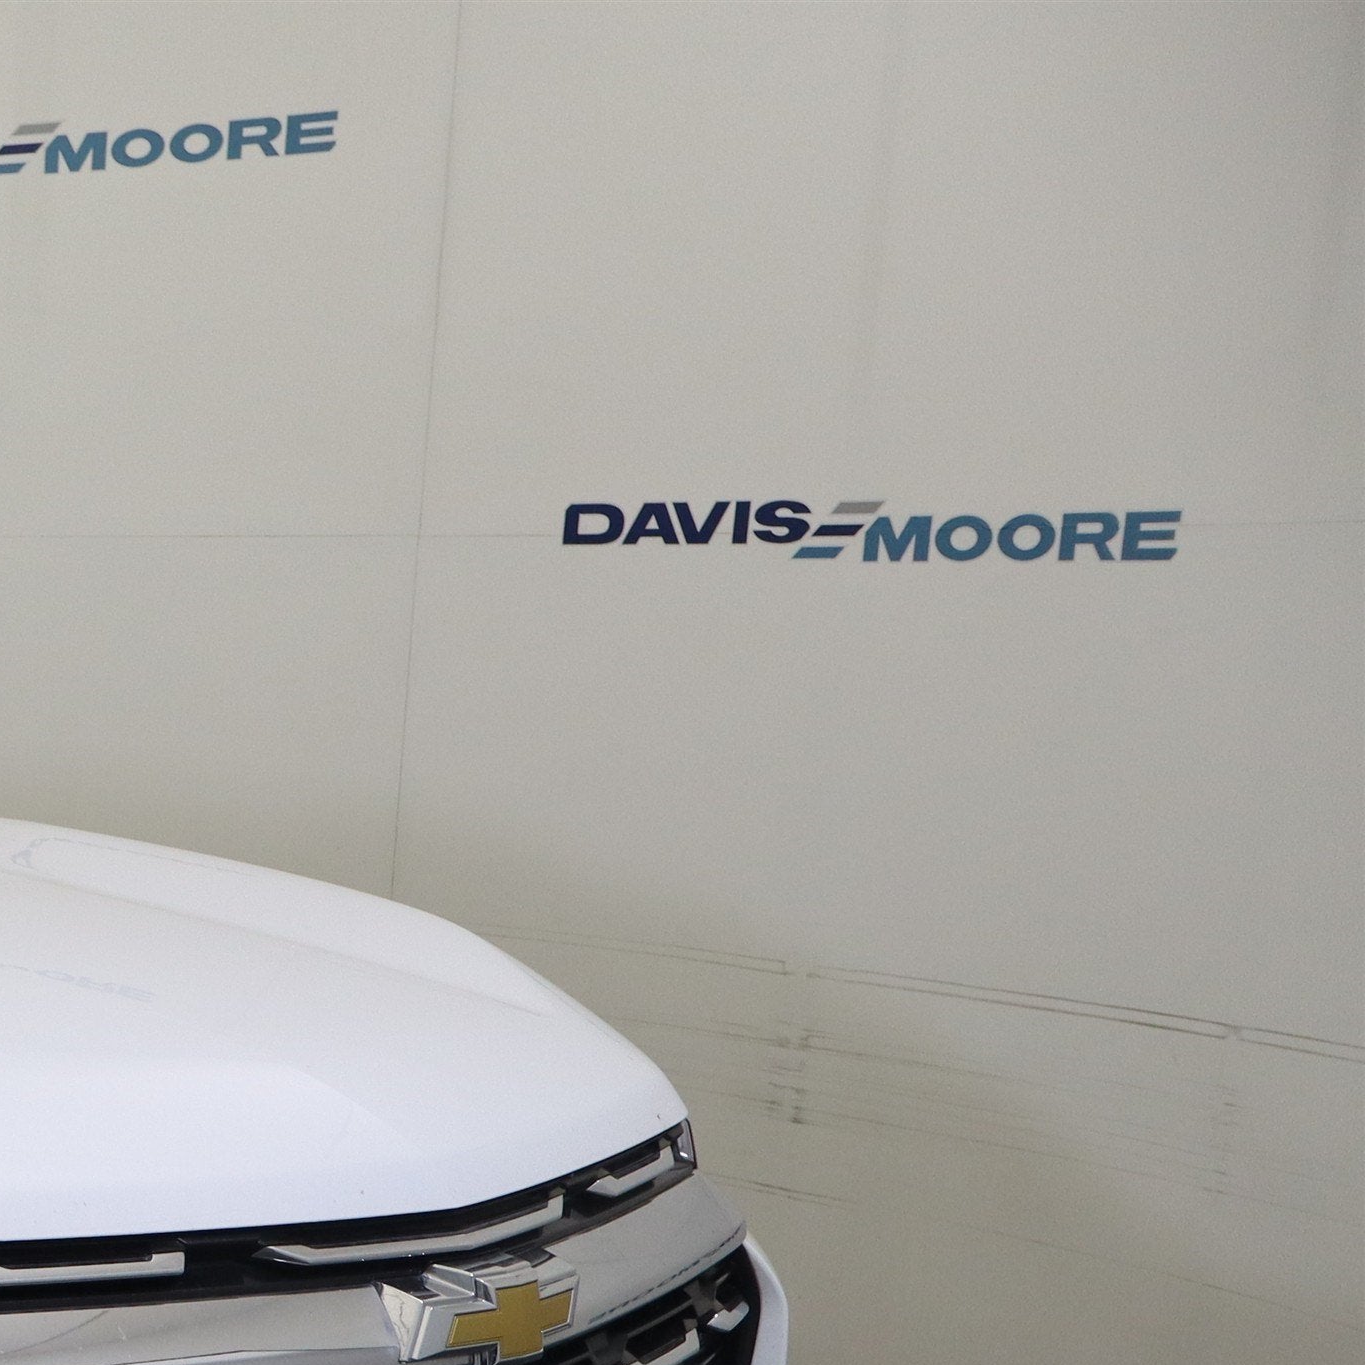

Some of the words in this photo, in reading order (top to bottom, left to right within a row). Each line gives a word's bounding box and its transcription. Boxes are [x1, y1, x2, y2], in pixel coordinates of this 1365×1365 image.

[43, 109, 338, 175] MOORE
[563, 498, 810, 544] DAVIS
[861, 509, 1183, 563] MOORE
